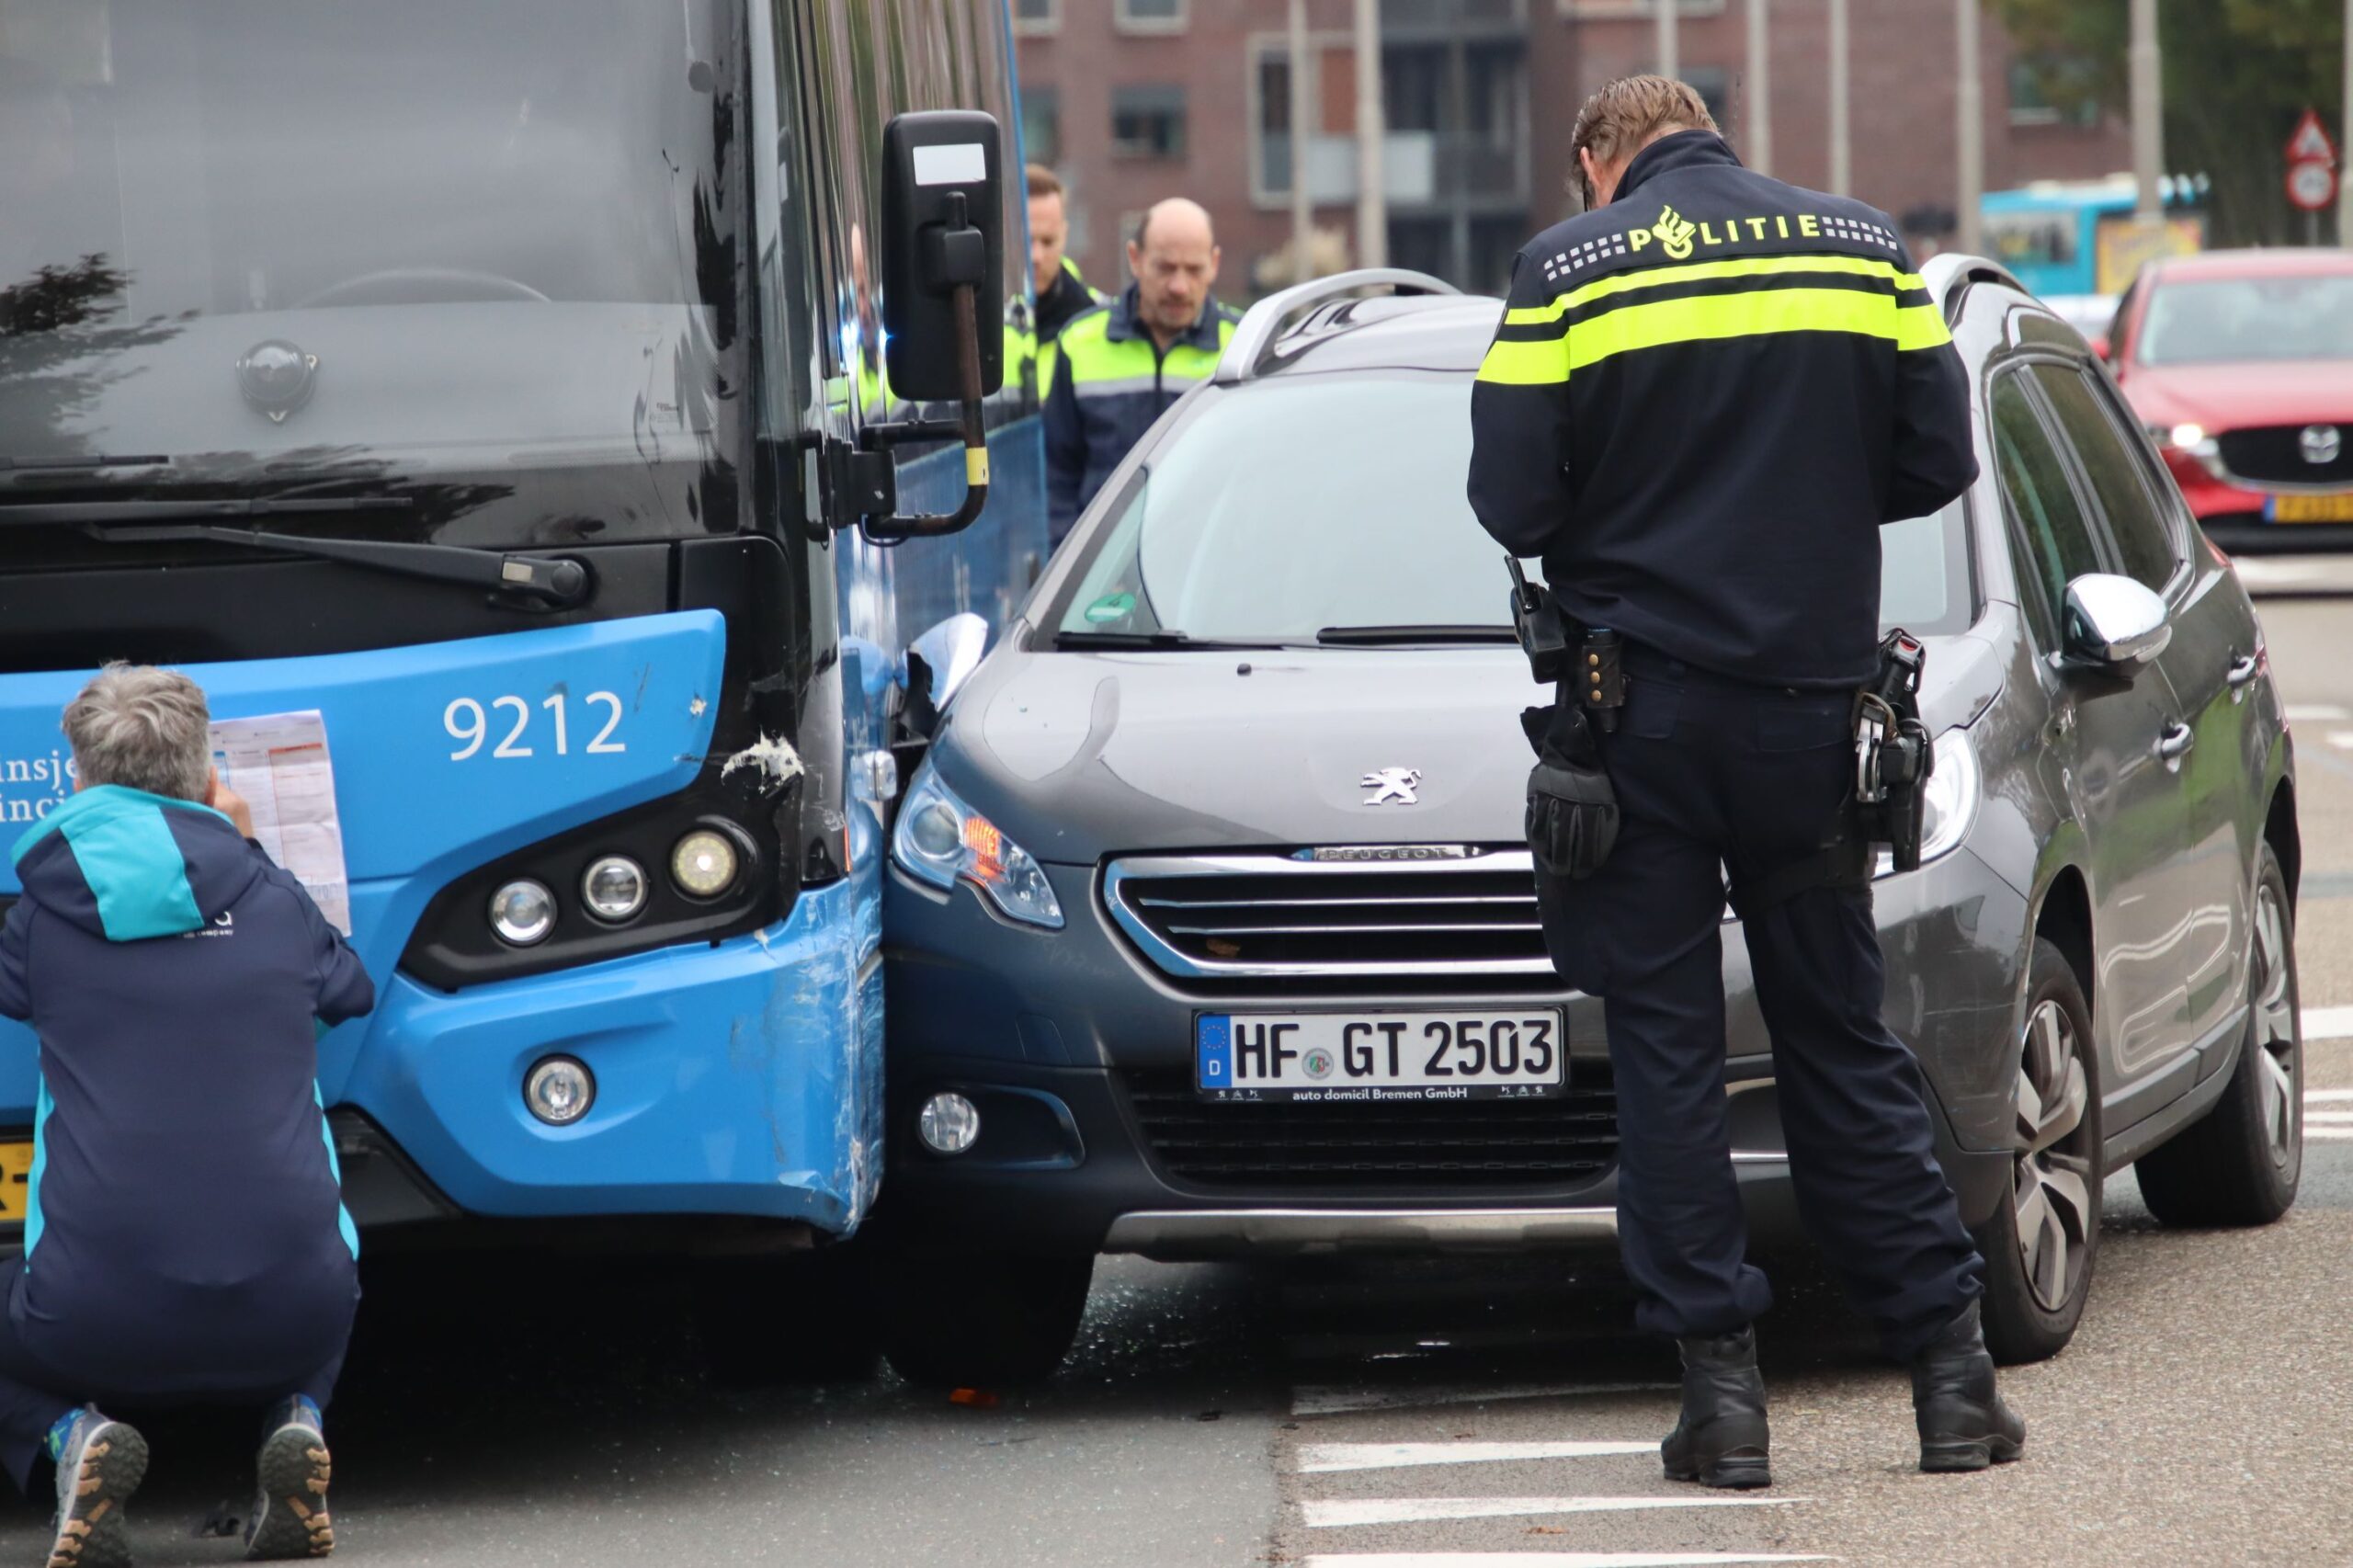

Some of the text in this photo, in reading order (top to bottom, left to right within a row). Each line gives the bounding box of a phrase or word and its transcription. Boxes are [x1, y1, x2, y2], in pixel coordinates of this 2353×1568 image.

[1628, 211, 1821, 259] POLITIE
[443, 690, 626, 761] 9212
[1325, 846, 1448, 860] PEUGEOT
[1235, 1019, 1553, 1079] HF GT 2503
[1208, 1060, 1222, 1076] D
[1292, 1086, 1468, 1101] auto domicil Bremen GmbH
